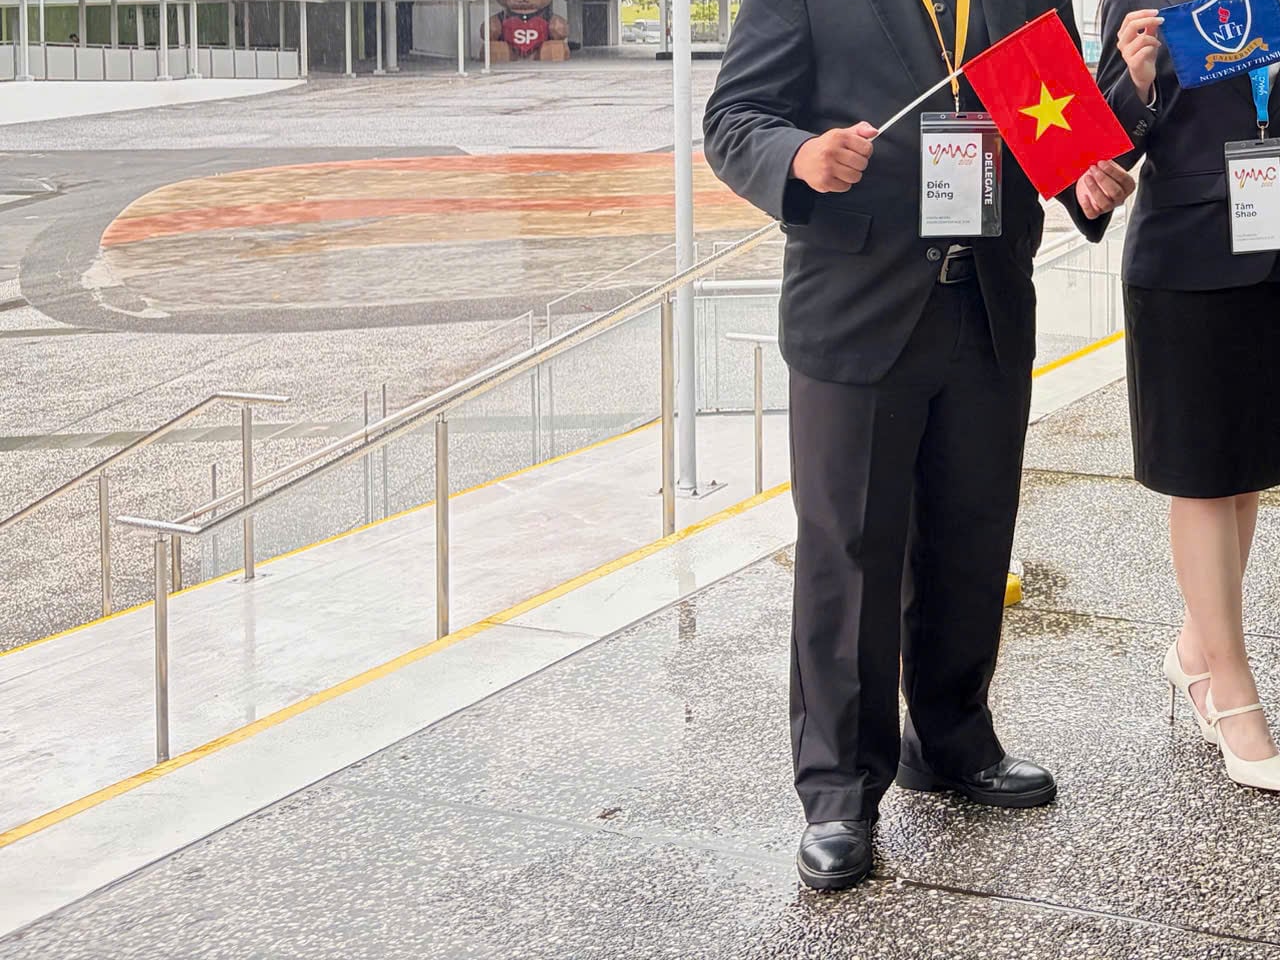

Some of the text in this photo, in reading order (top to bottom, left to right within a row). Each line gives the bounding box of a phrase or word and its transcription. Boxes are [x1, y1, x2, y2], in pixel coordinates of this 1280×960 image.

[512, 28, 539, 45] SP
[1212, 21, 1244, 44] NTT
[1200, 67, 1236, 82] NGUYEN
[984, 152, 993, 206] DELEGATE
[1235, 210, 1257, 218] Shao
